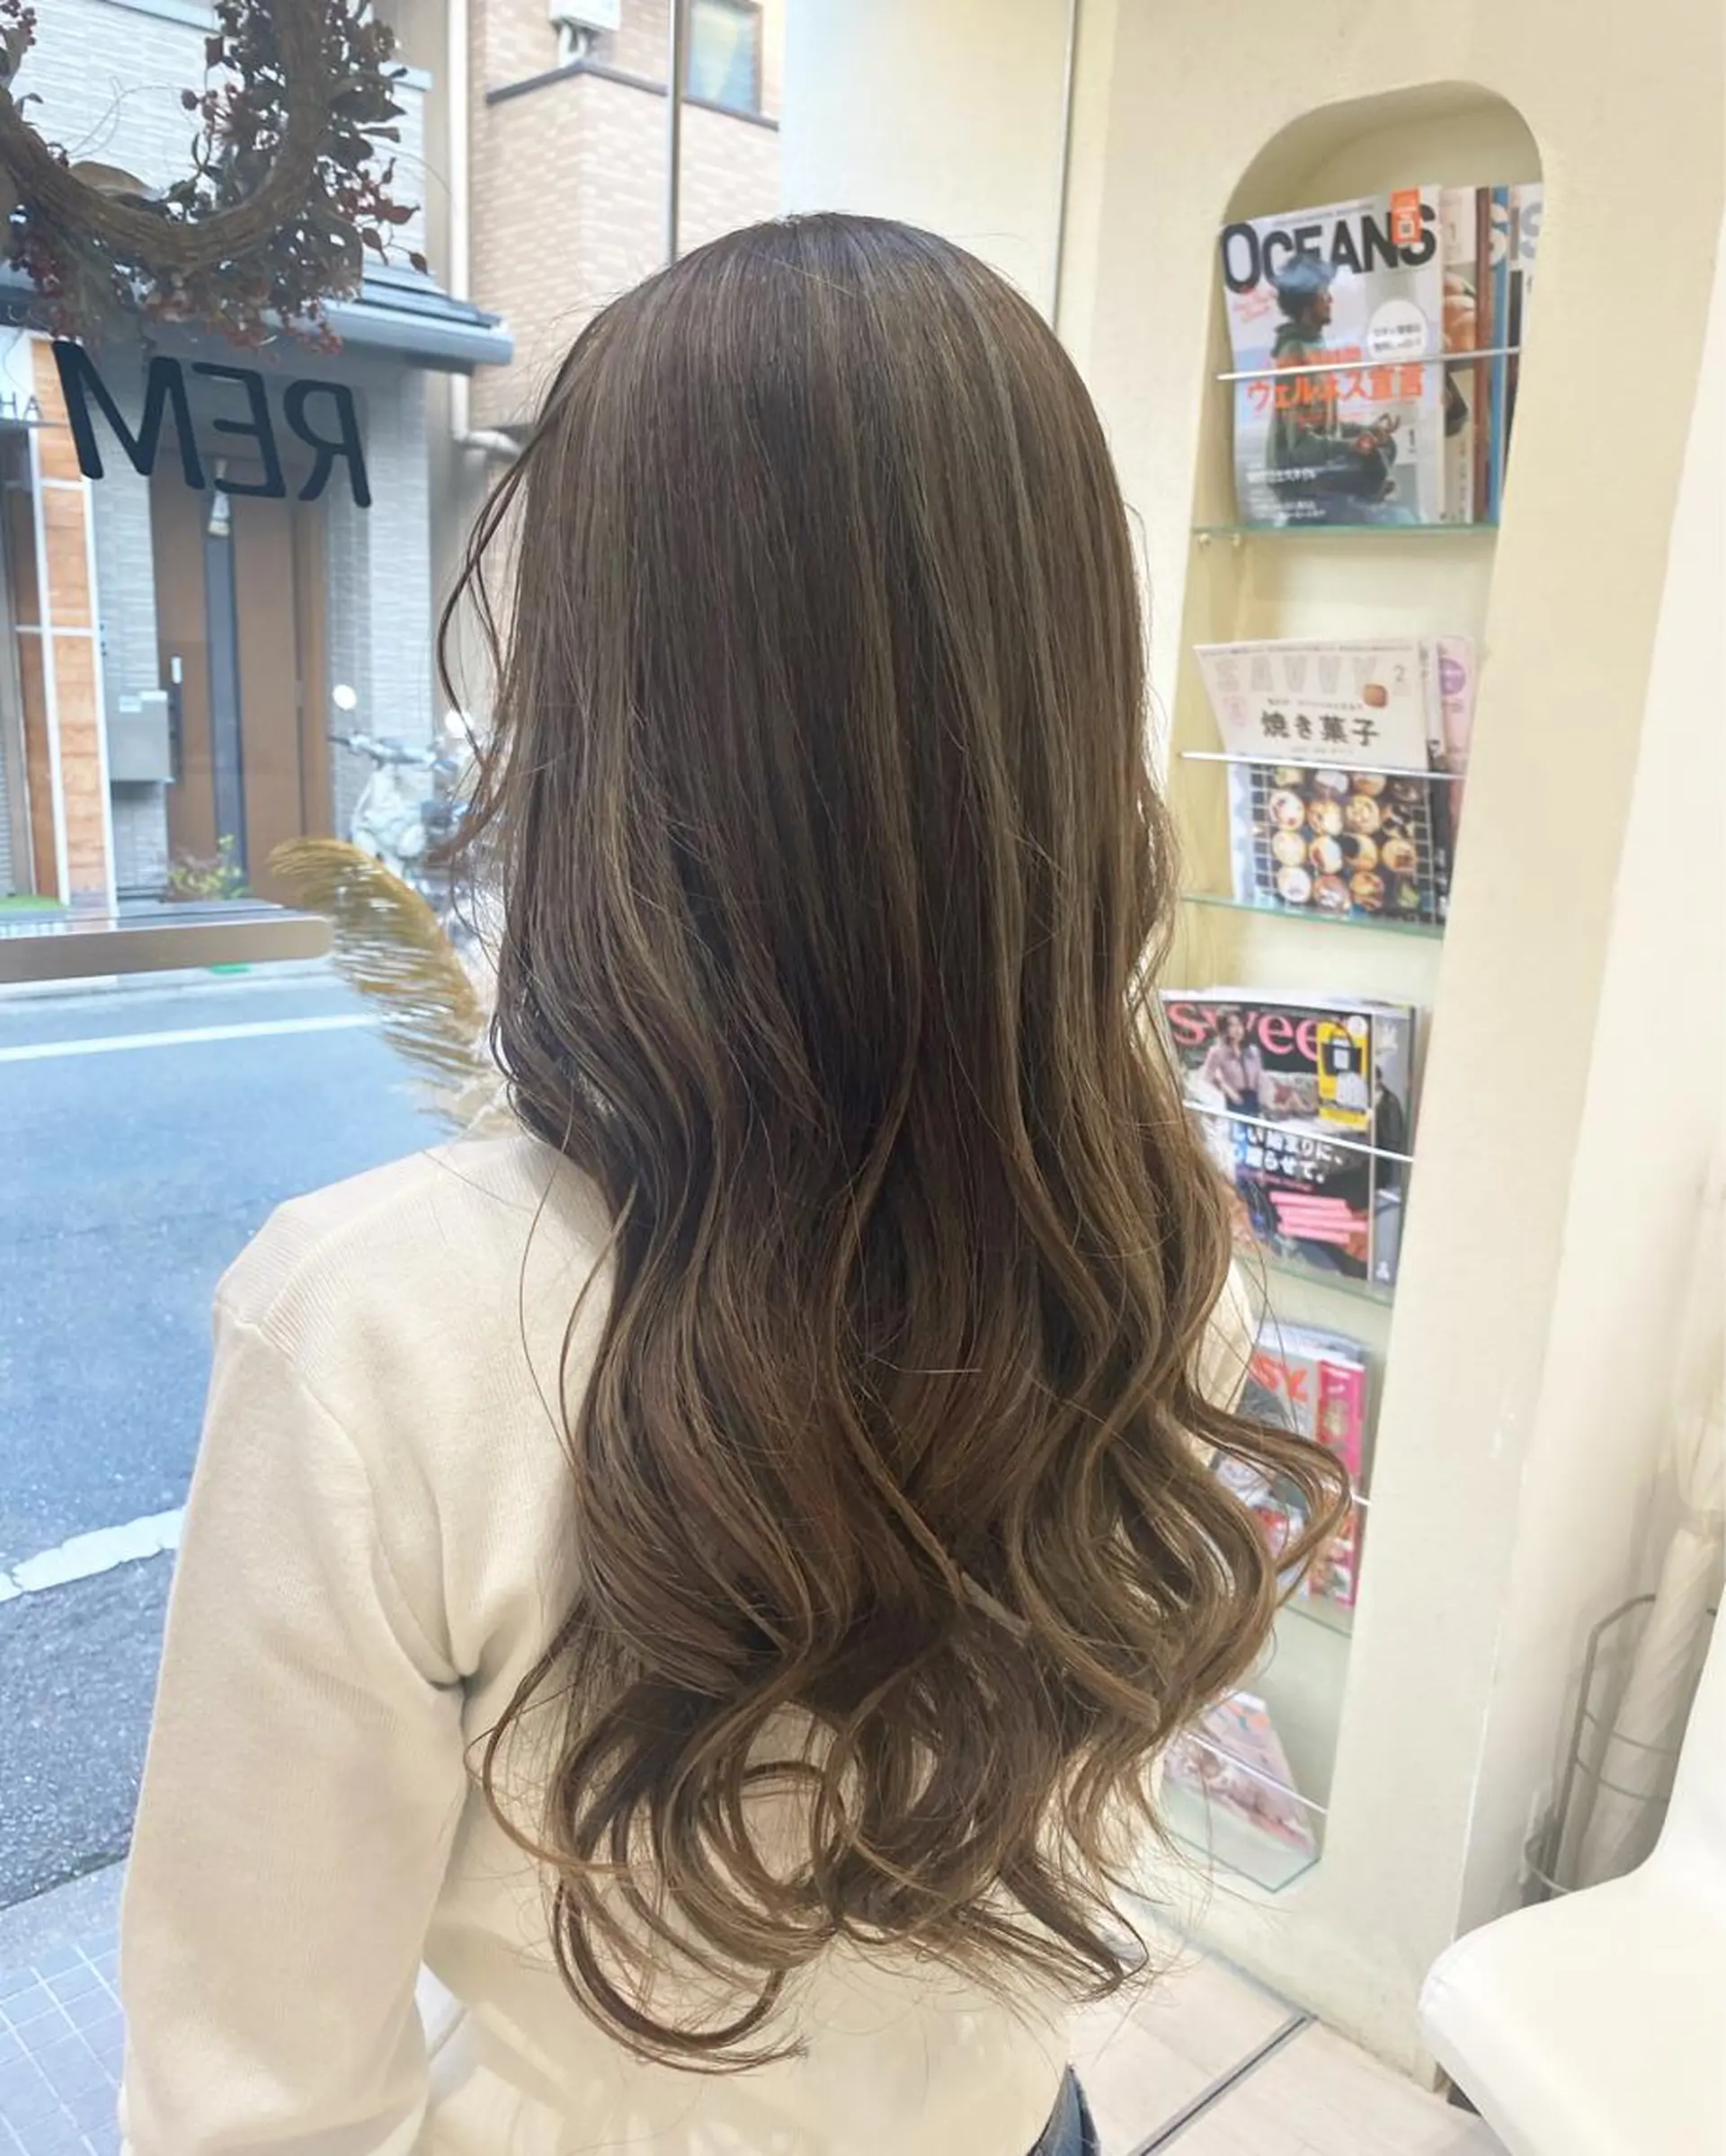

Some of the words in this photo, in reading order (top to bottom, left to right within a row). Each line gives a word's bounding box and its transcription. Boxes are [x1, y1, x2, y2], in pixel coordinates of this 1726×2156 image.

[1220, 203, 1437, 295] OCEANS
[1259, 709, 1381, 748] 焼き菓子
